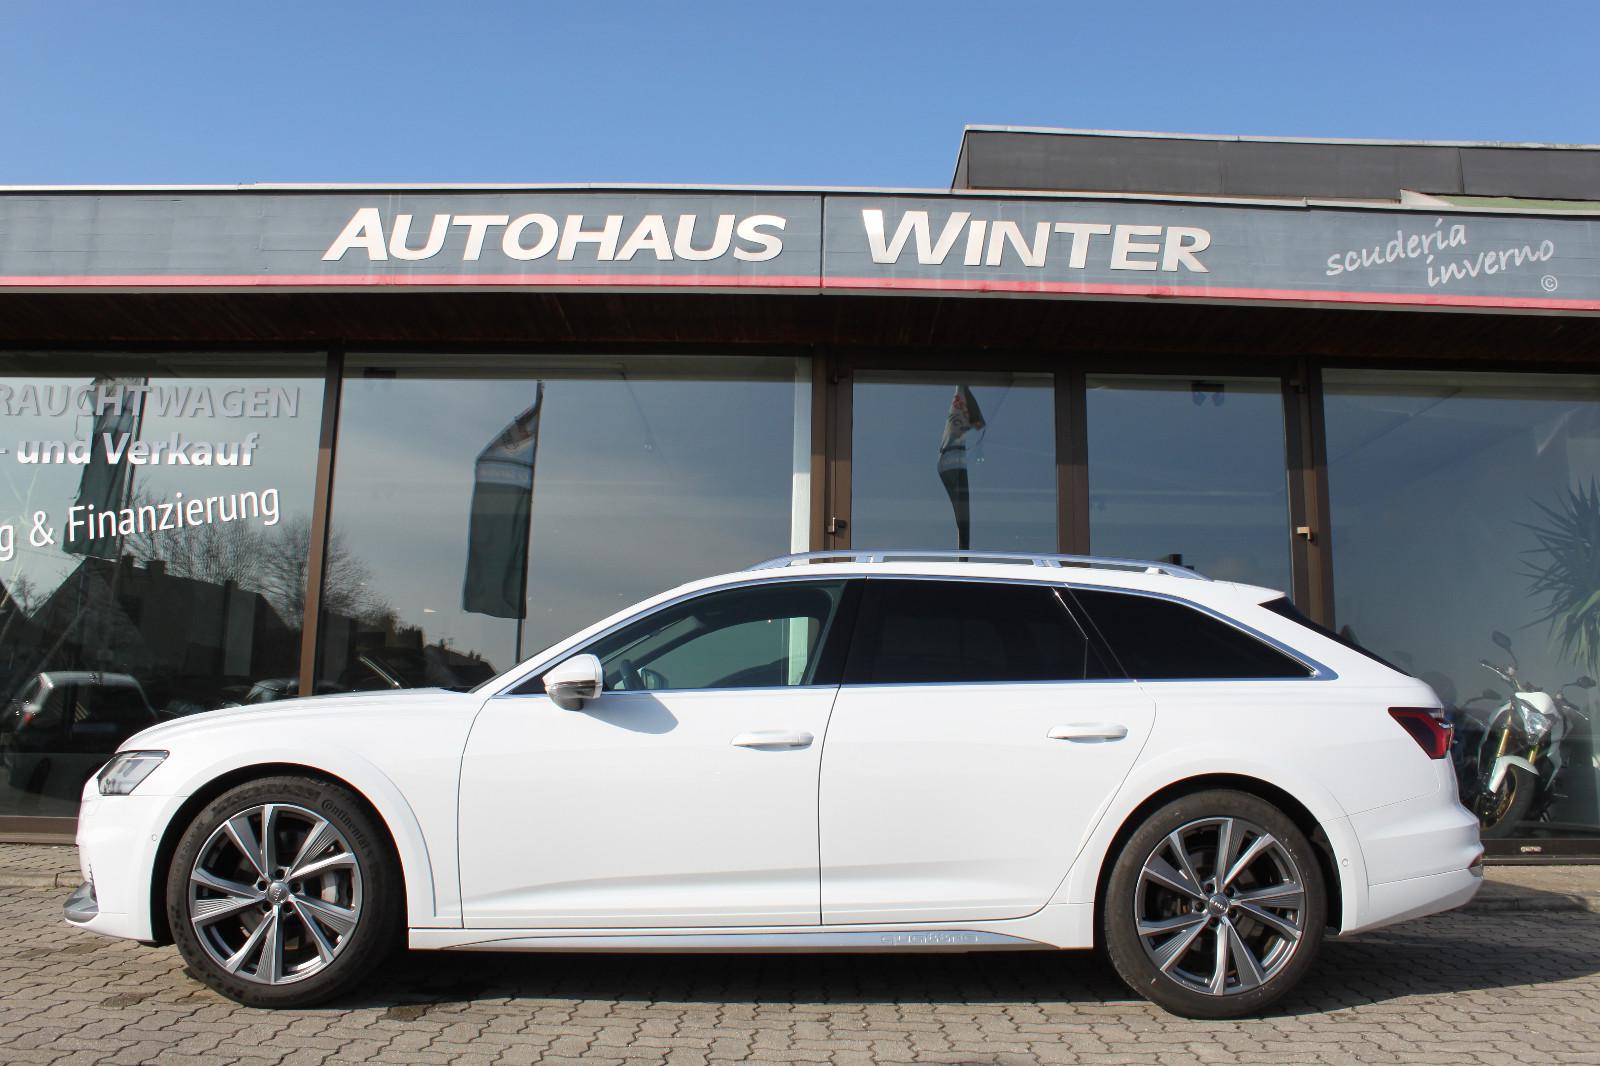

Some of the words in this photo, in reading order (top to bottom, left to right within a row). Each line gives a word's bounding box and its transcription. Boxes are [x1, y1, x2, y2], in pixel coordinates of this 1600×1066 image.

[321, 207, 787, 262] AUTOHAUS
[862, 209, 1211, 273] WINTER
[1326, 218, 1467, 276] scuderia
[1426, 240, 1555, 287] inverno
[17, 432, 93, 464] und
[103, 432, 259, 466] Verkauf
[30, 510, 55, 546] &
[68, 488, 281, 543] Finanzierung
